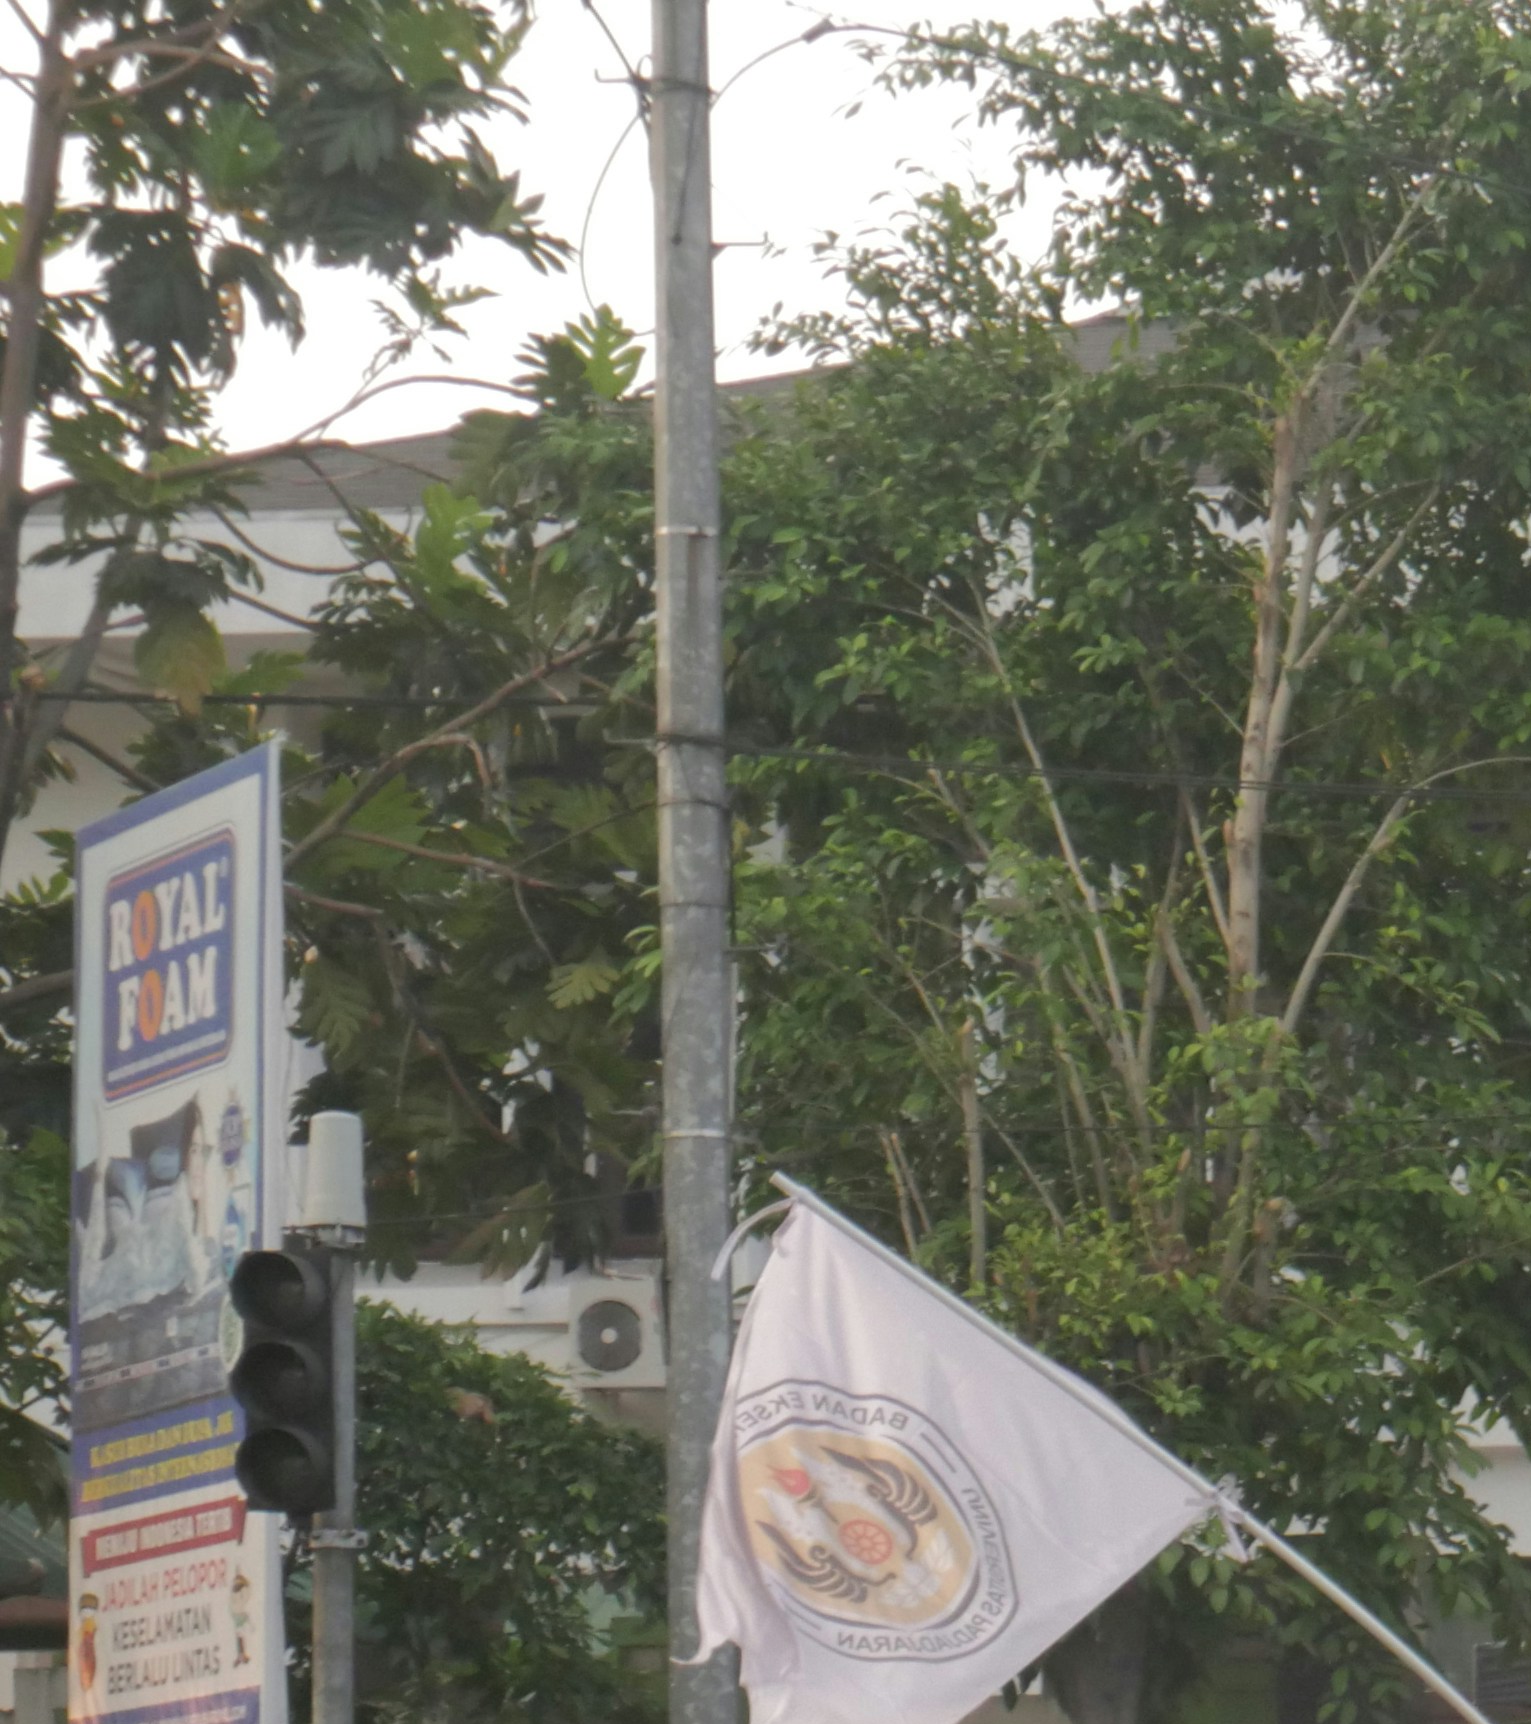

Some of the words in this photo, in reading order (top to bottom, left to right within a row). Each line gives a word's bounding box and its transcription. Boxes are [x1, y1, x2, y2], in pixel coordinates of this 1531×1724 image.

[109, 861, 226, 972] ROYAL
[117, 945, 218, 1051] FOAM
[103, 1571, 159, 1612] JADILAH
[163, 1558, 227, 1600] PELOPOR
[112, 1603, 212, 1652] KESELAMATAN
[107, 1655, 168, 1695] BERLALU
[172, 1645, 221, 1683] LINTAS
